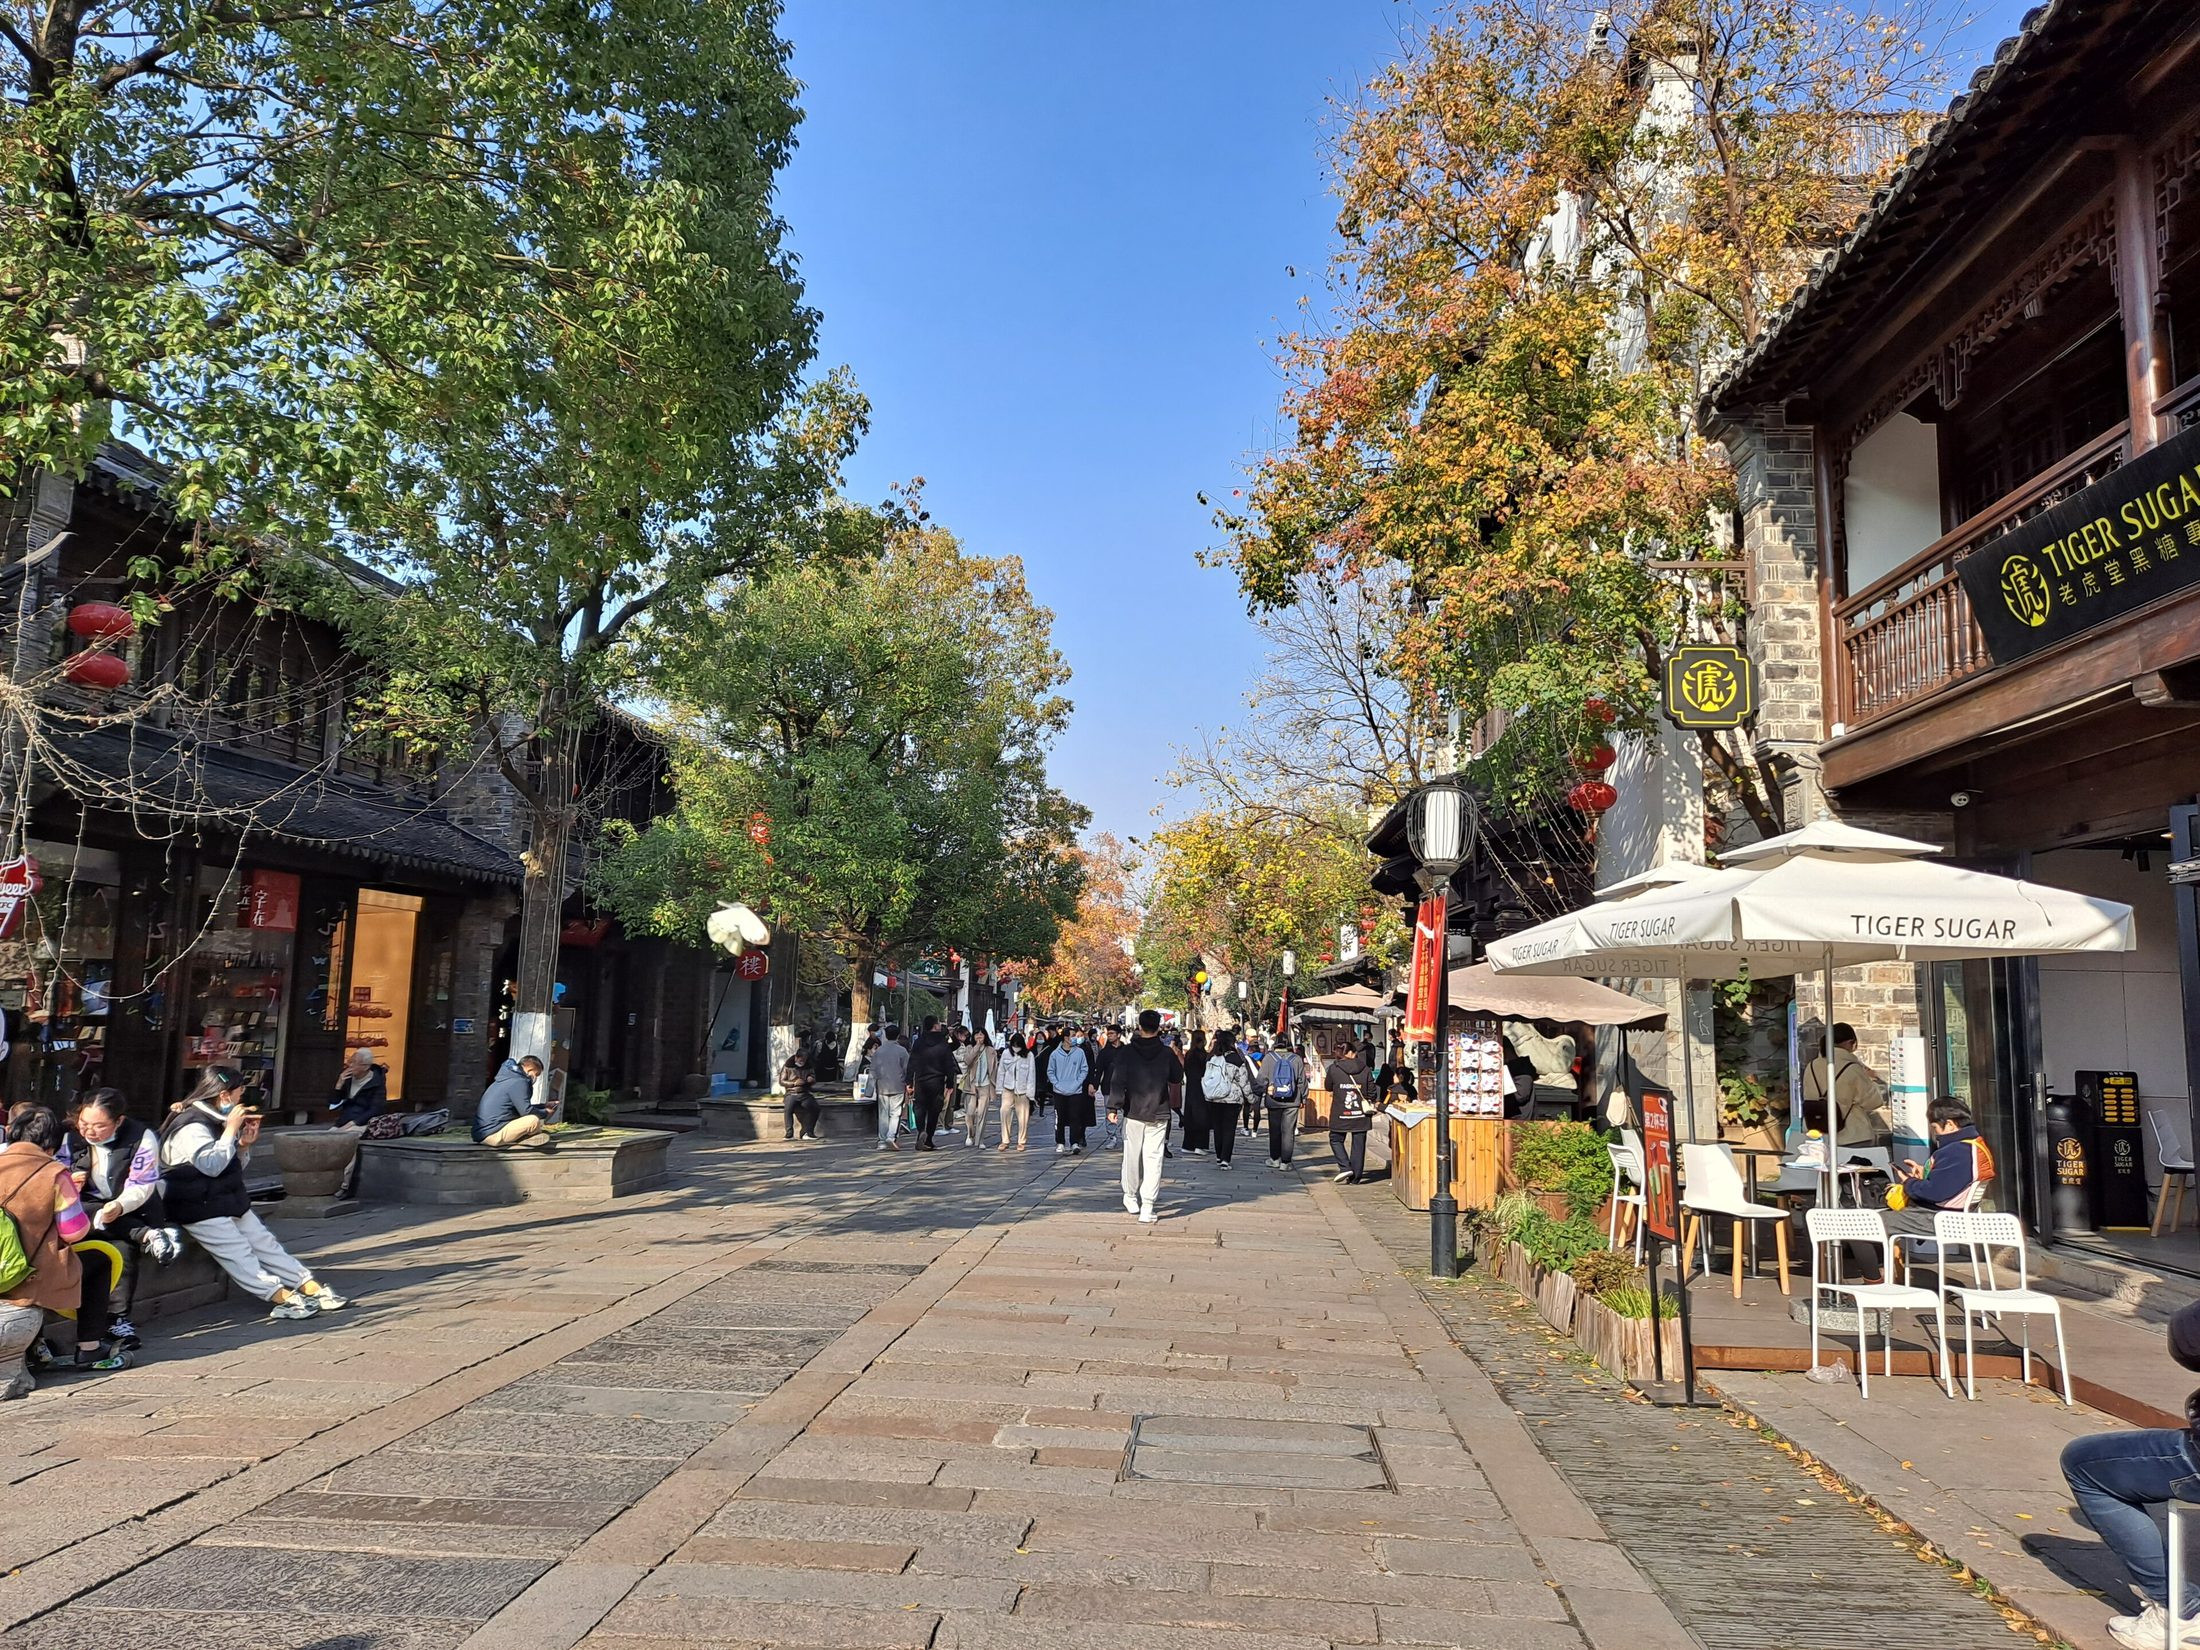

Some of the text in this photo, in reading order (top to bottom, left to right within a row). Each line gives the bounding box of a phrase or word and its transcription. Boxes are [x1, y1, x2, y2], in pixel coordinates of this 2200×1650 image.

[2042, 464, 2200, 577] TIGER SUGA
[1610, 916, 1676, 940] TIGER SUGAR
[1850, 914, 2016, 940] TIGER SUGAR
[1512, 939, 1559, 961] TIGER SUGAR
[133, 1157, 145, 1170] 9
[2056, 1160, 2084, 1168] TIGER
[2056, 1167, 2084, 1176] SUGAR
